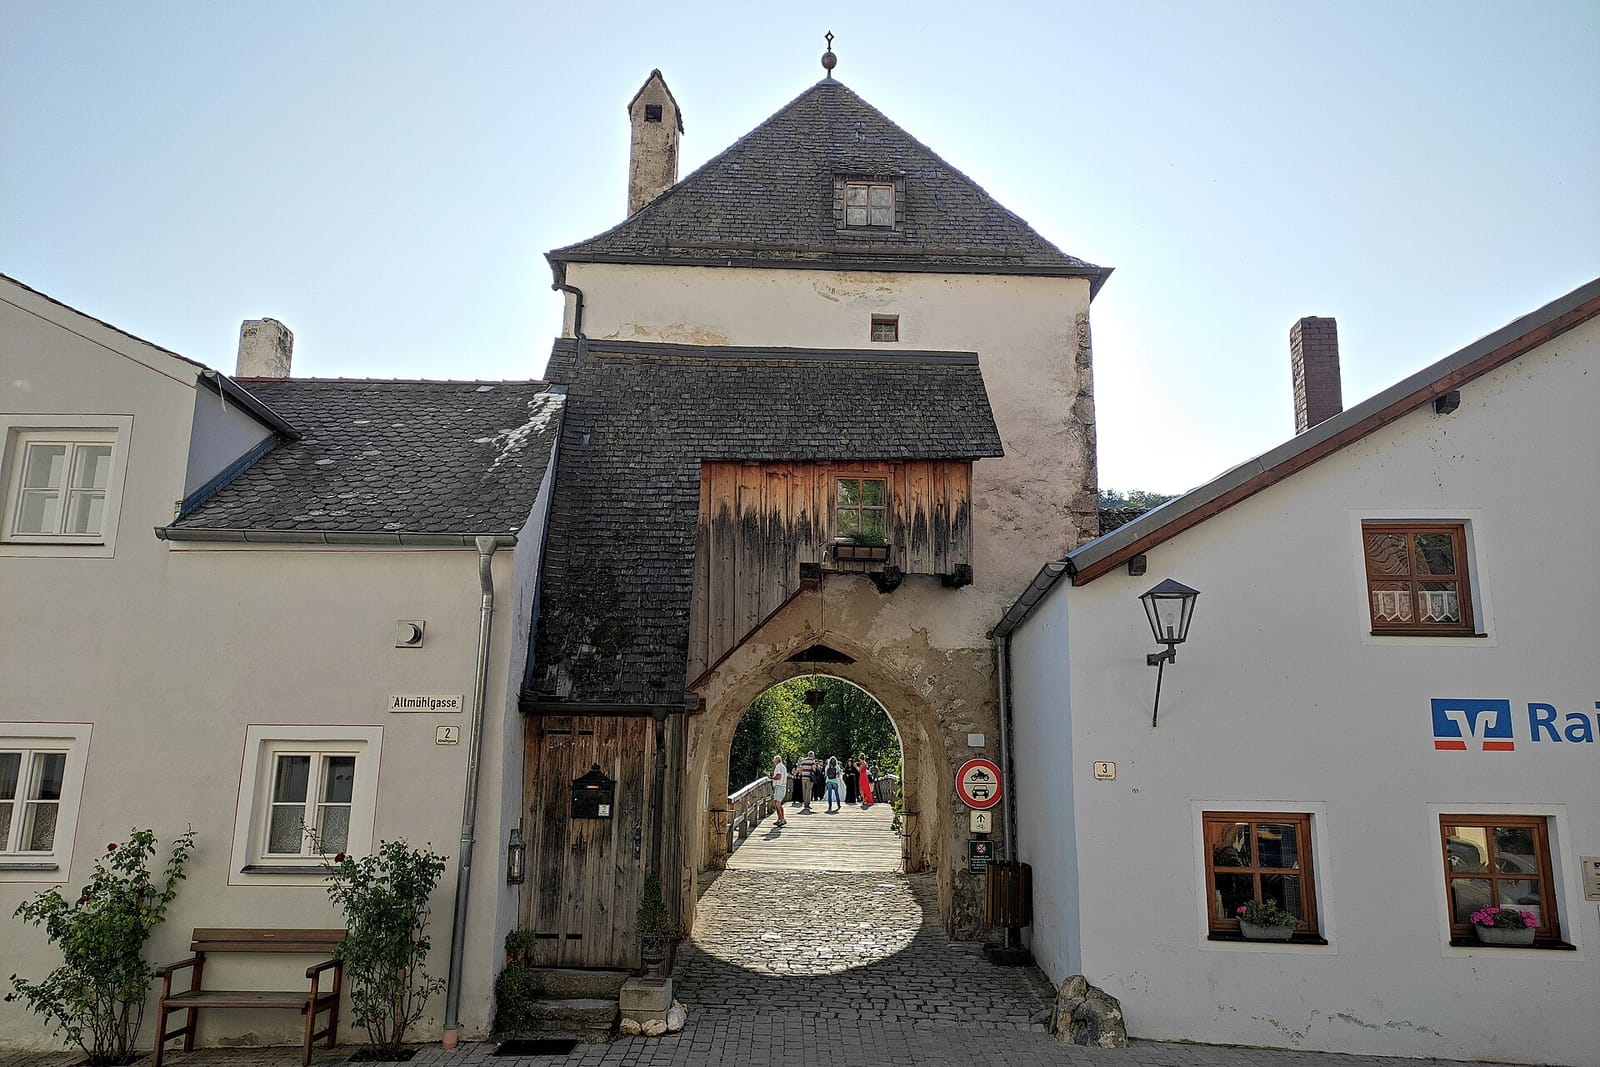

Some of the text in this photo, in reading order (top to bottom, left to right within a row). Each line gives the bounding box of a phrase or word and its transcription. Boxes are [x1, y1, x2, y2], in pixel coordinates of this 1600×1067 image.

[393, 696, 457, 711] Altmühlgasse
[1527, 701, 1600, 743] Ra
[445, 727, 451, 739] 2
[1102, 763, 1108, 774] 3
